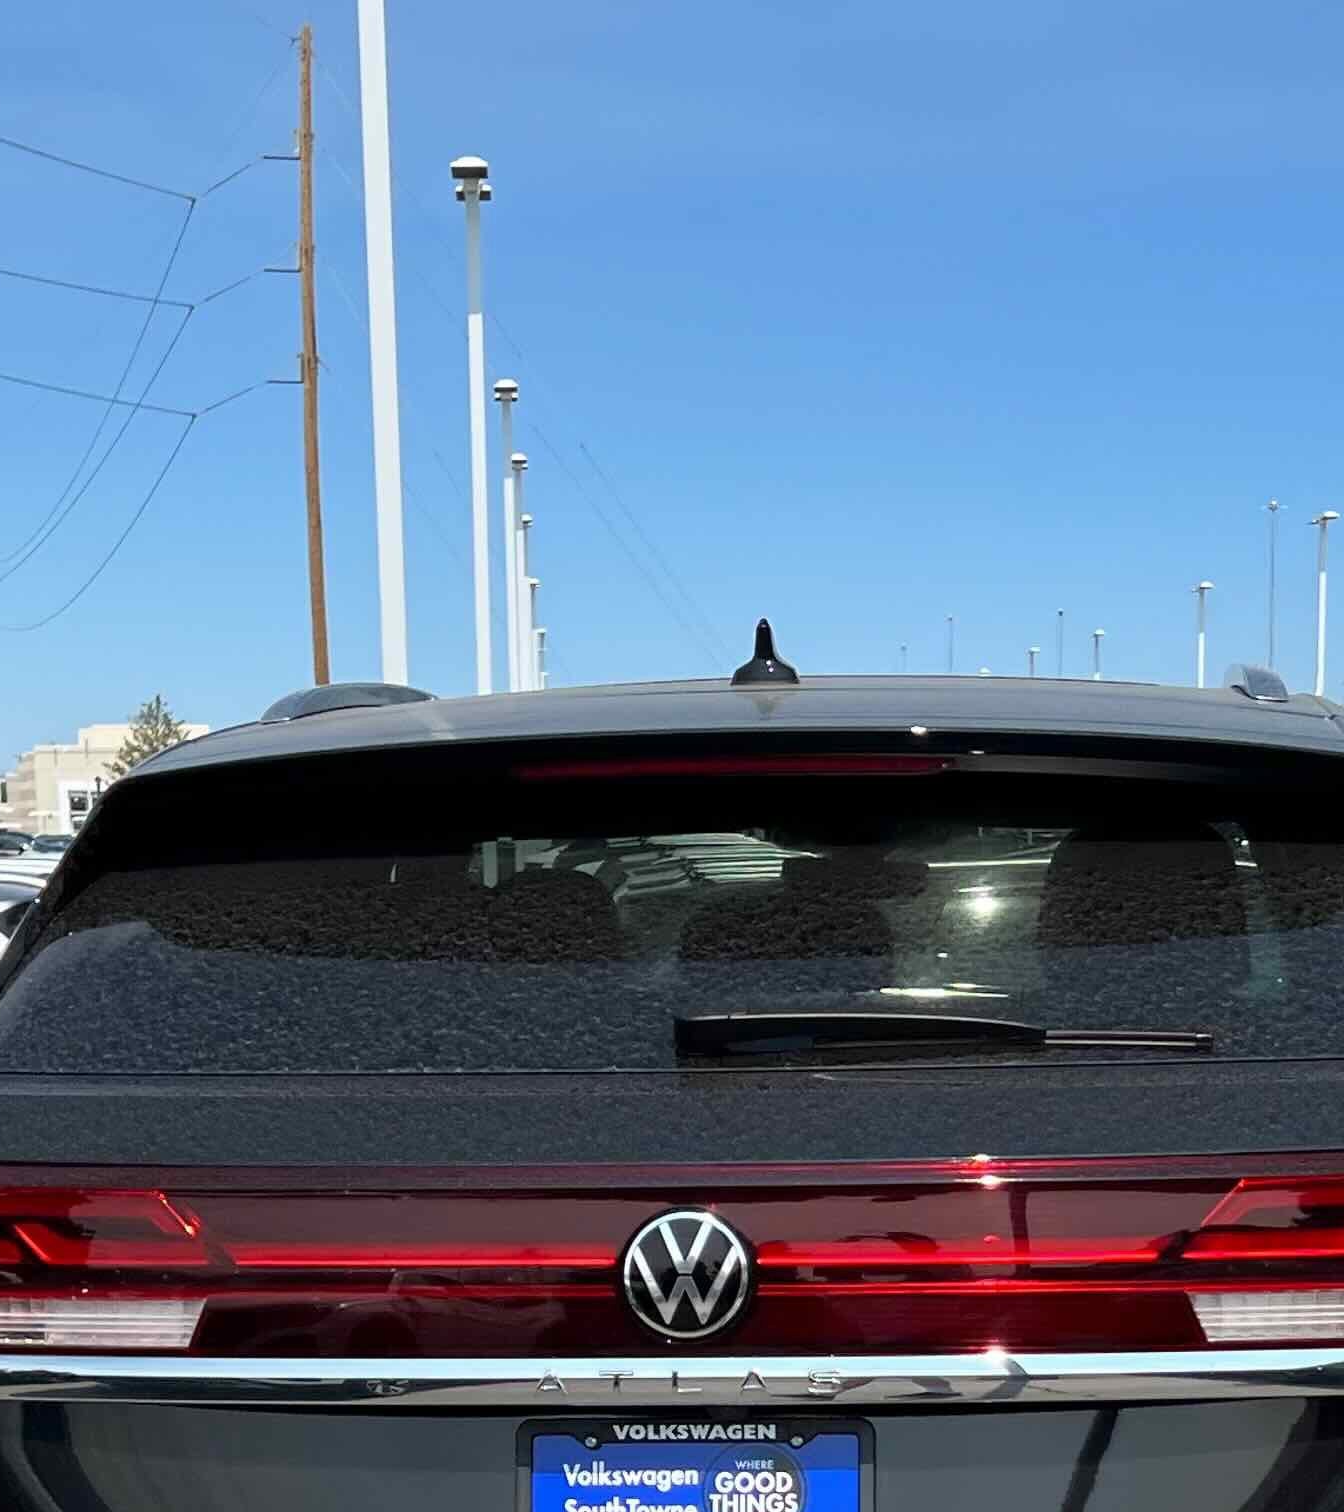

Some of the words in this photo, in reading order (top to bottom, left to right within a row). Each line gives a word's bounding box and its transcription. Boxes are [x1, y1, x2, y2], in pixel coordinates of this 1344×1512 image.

[535, 1368, 842, 1394] ATLAS
[612, 1424, 777, 1440] VOLKSWAGEN
[735, 1460, 774, 1470] WHERE
[562, 1461, 699, 1492] Volkswagen
[715, 1471, 793, 1493] GOOD
